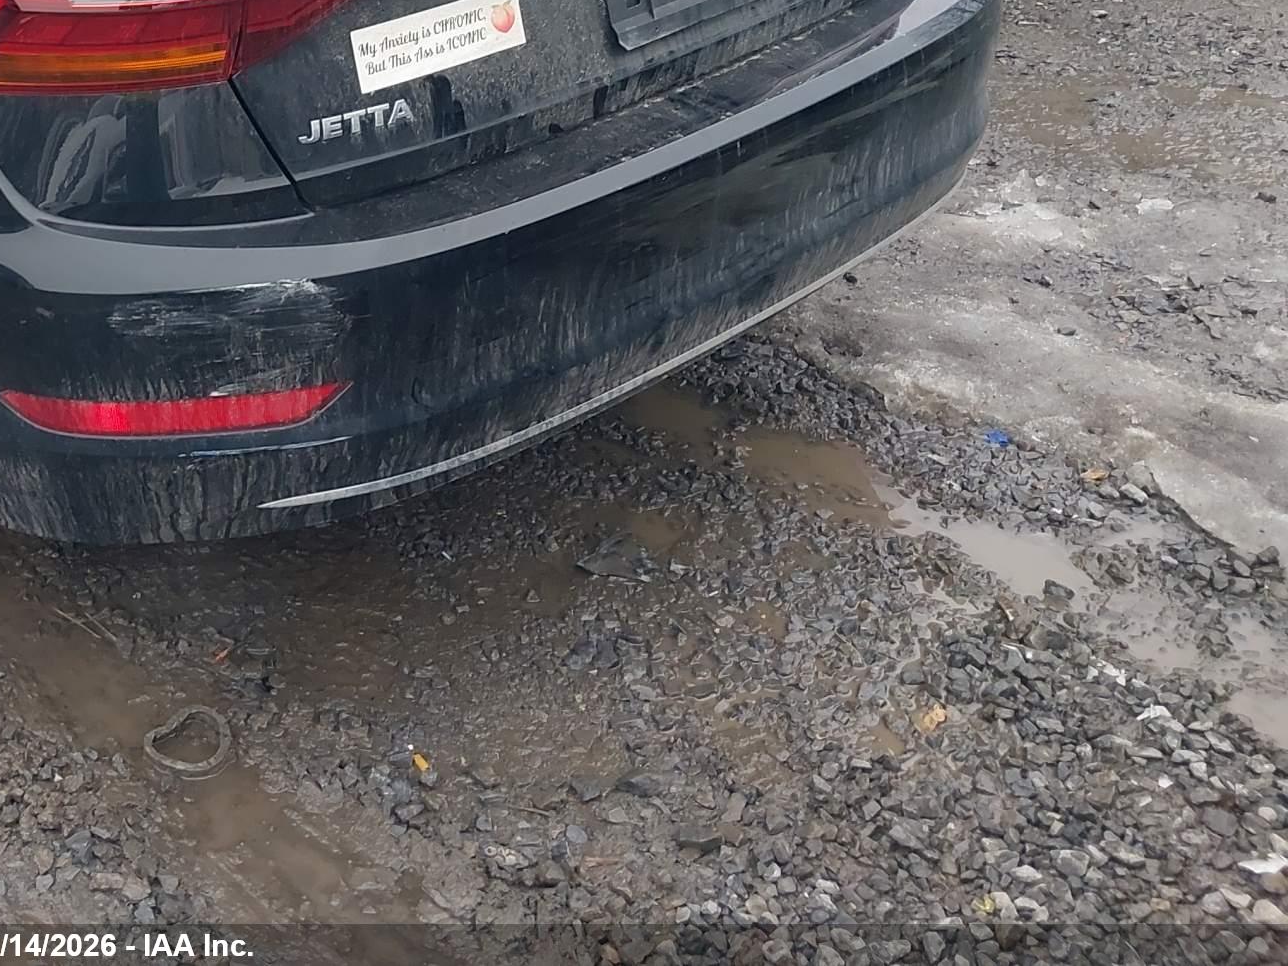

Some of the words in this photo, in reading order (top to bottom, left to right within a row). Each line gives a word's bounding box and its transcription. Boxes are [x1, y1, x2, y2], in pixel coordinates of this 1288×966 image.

[358, 41, 377, 58] My
[379, 30, 419, 51] Anxiety
[421, 26, 432, 39] is
[432, 7, 487, 36] CHRONIC,
[365, 60, 386, 76] But
[388, 51, 413, 70] This
[414, 47, 434, 63] Ass
[435, 43, 446, 55] is
[446, 27, 488, 51] ICONIC
[297, 98, 414, 144] JETTA
